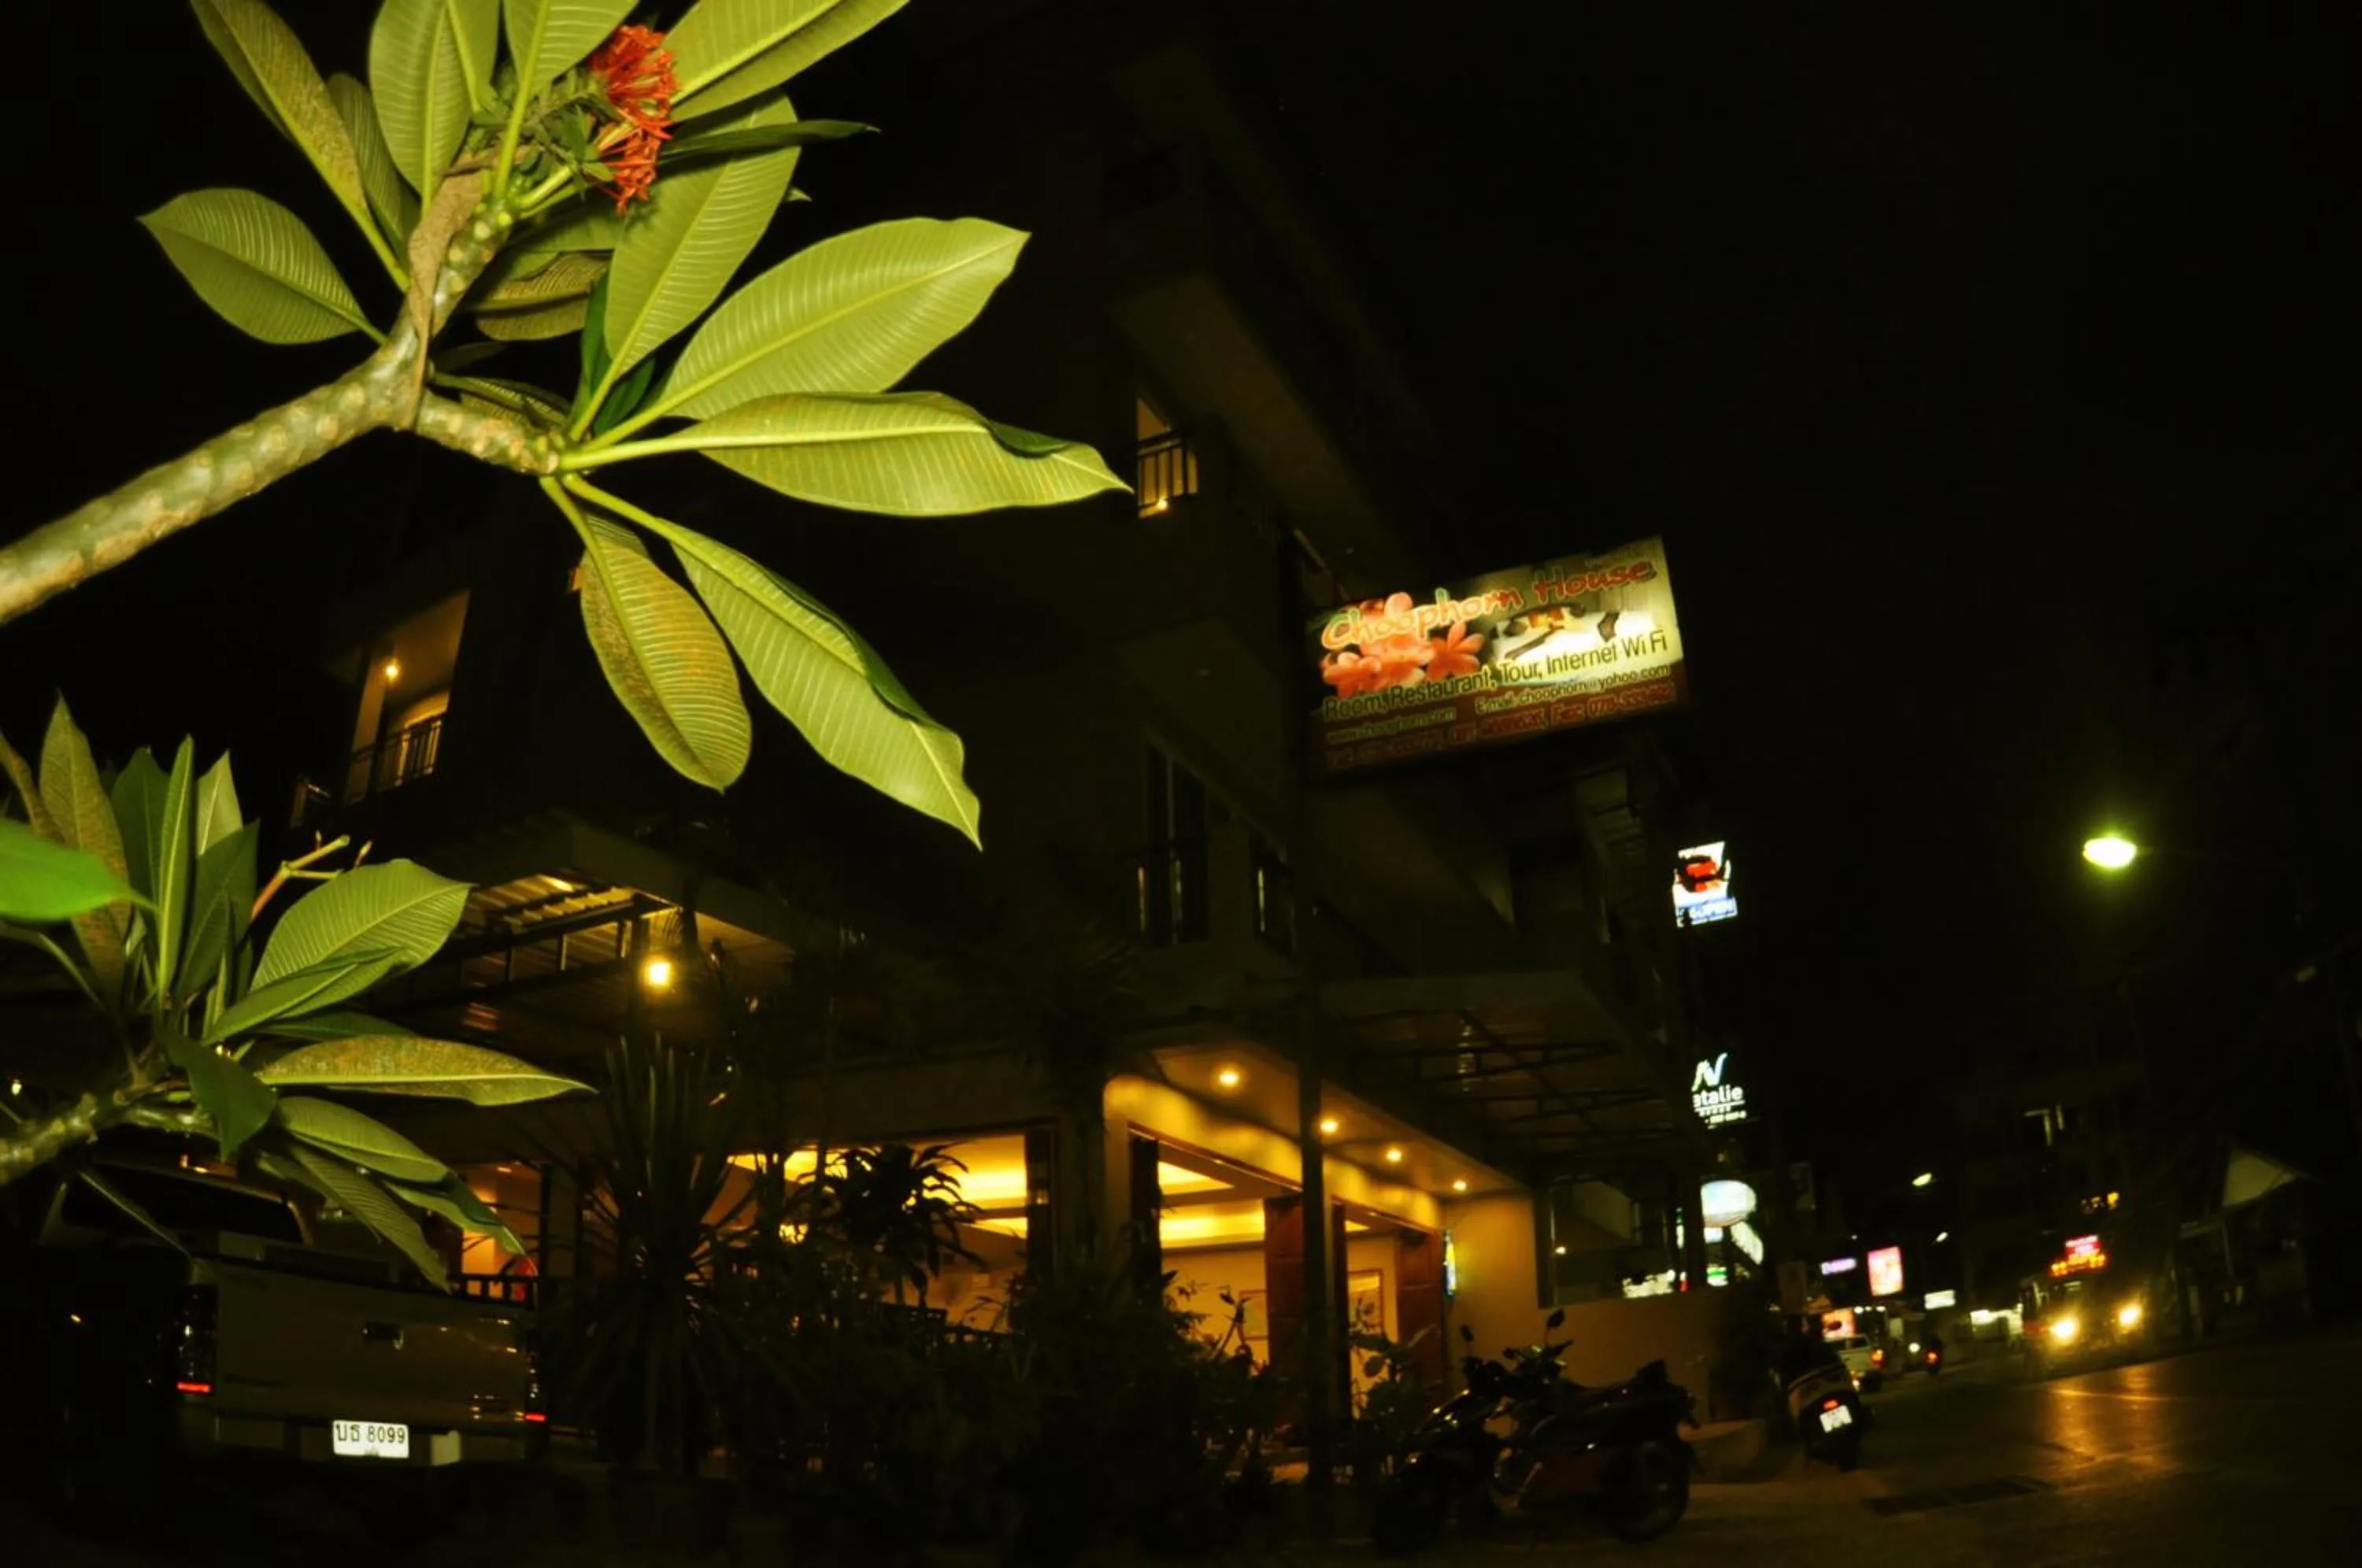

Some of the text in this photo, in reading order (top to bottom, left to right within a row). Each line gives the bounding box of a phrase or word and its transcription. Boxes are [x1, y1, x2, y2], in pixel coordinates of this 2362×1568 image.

[1533, 559, 1657, 605] House
[1324, 630, 1668, 721] Room, Restaurant, Tour, Internet Wi Fi
[368, 1426, 405, 1444] 8099
